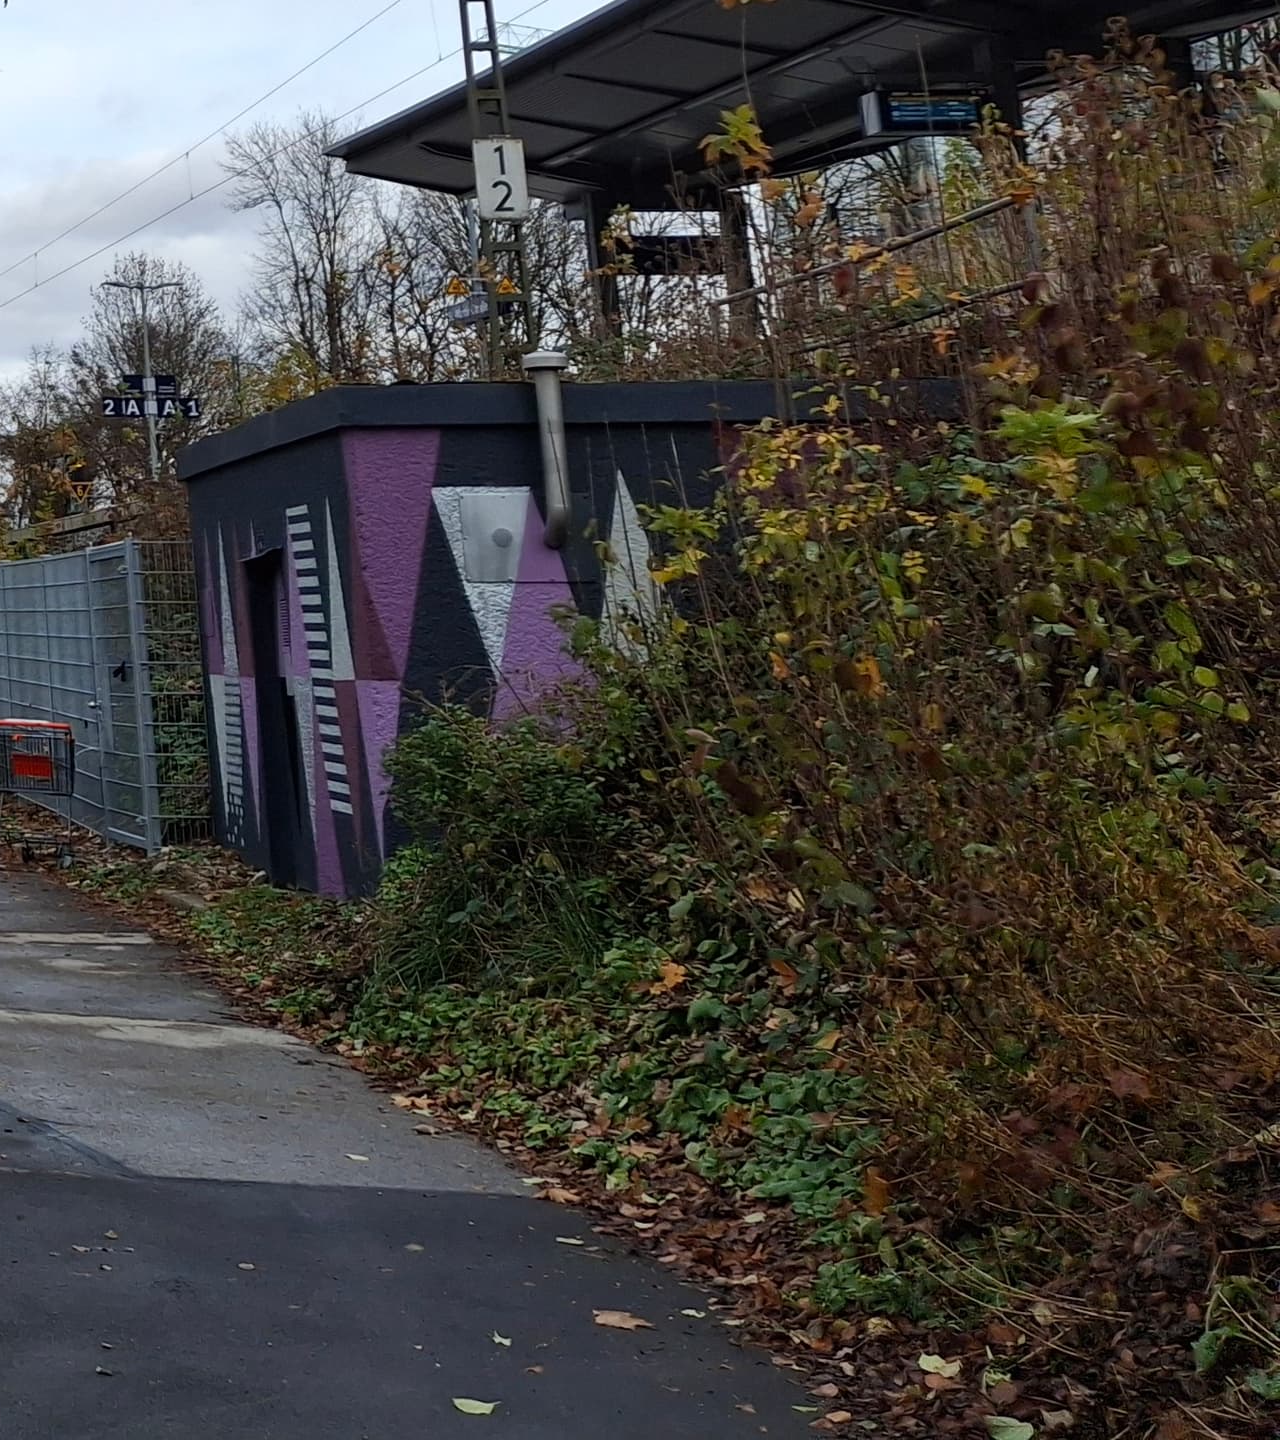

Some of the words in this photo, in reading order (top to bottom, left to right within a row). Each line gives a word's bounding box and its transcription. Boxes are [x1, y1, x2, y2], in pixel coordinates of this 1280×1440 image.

[493, 144, 506, 175] 1
[492, 180, 515, 212] 2
[103, 399, 115, 415] 2
[126, 399, 140, 416] A
[163, 399, 176, 416] A
[187, 400, 200, 417] 1
